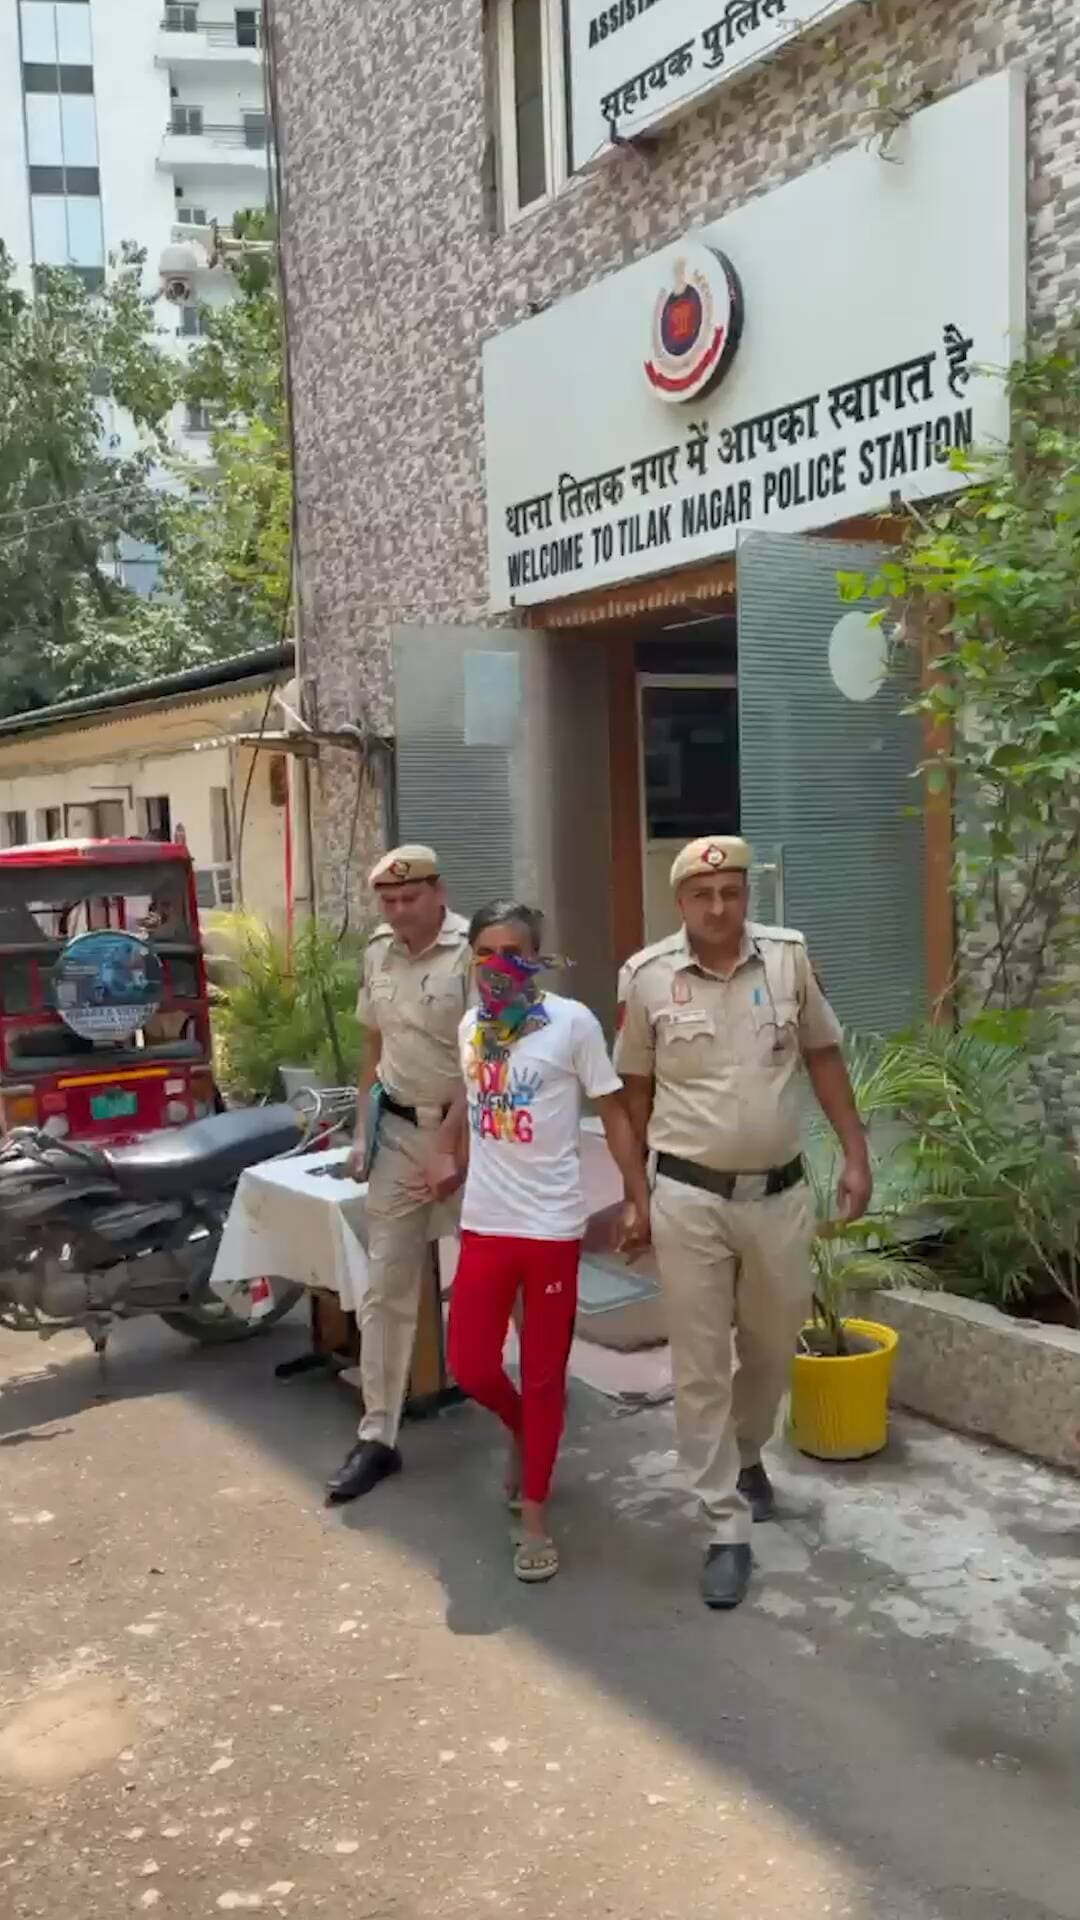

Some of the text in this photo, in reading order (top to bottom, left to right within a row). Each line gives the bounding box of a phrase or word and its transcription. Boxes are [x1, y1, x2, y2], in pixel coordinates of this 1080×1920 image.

[600, 38, 695, 122] सहायक
[505, 323, 974, 537] थाना तिलक नगर में आपका स्वागत है
[508, 407, 973, 587] WELCOME TO TILAK NAGAR POLICE STATION
